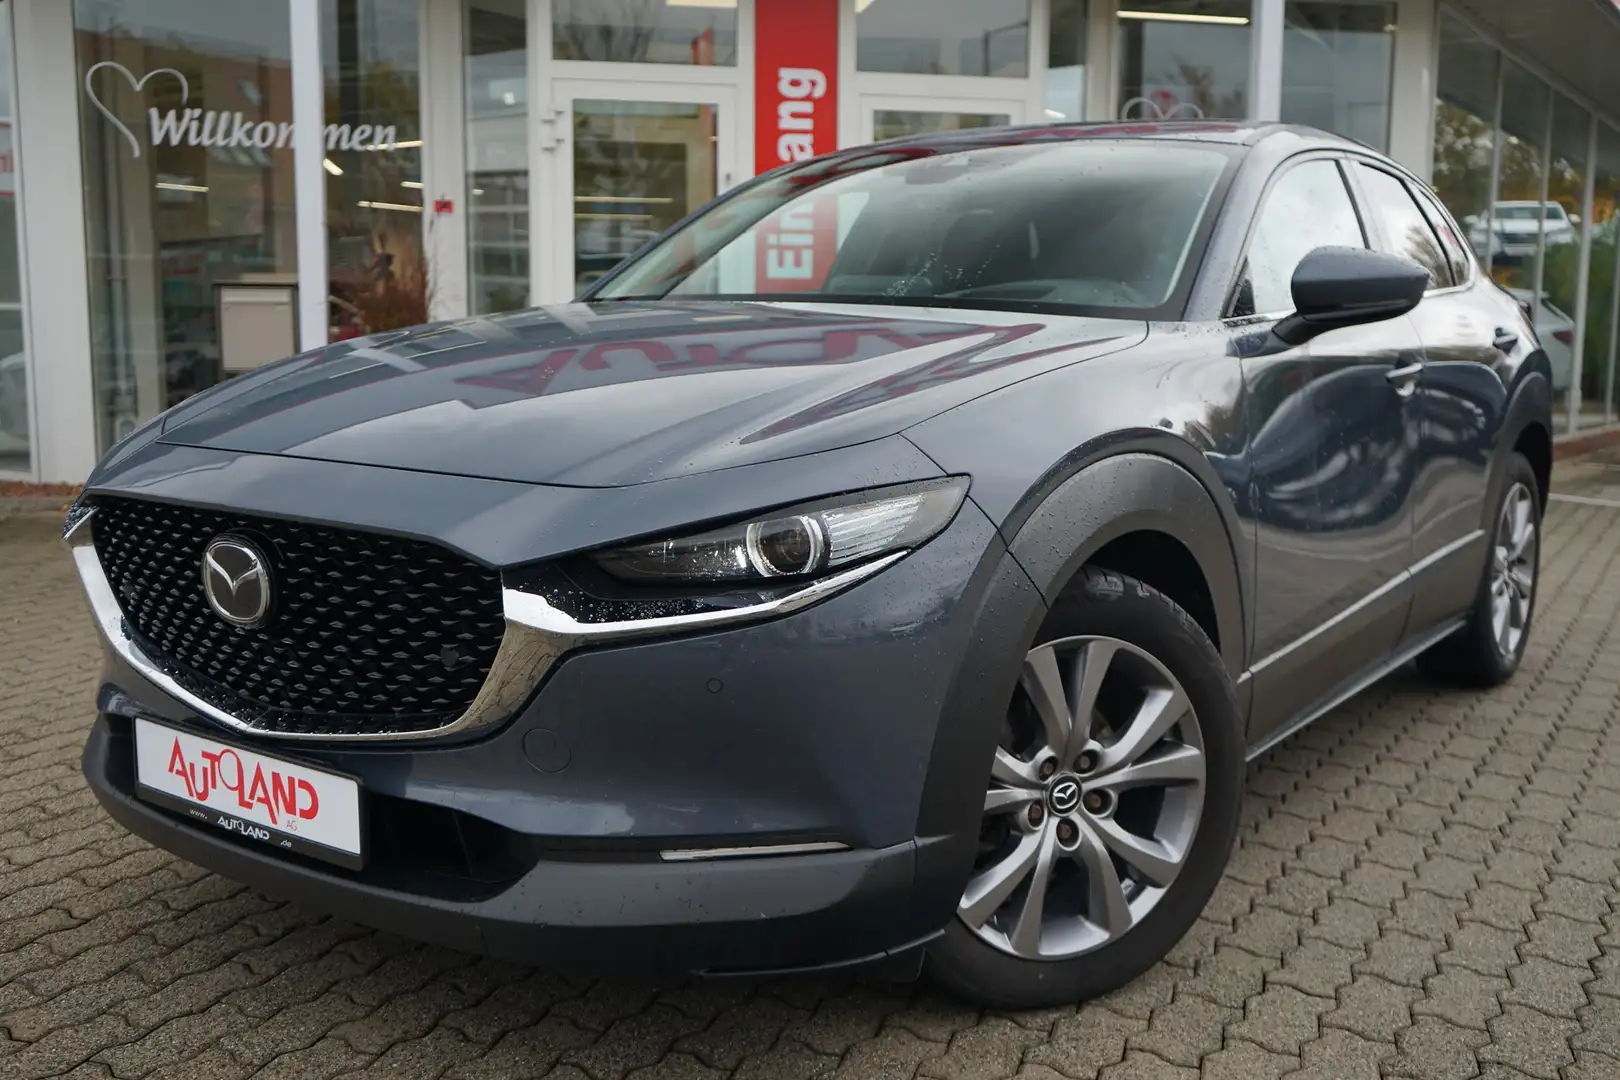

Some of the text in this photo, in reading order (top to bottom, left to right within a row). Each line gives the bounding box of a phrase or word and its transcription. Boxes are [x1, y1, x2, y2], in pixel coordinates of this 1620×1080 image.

[766, 67, 827, 279] Einang
[168, 736, 319, 825] AUTOLAND
[190, 808, 292, 848] www. AUTOLAND .de
